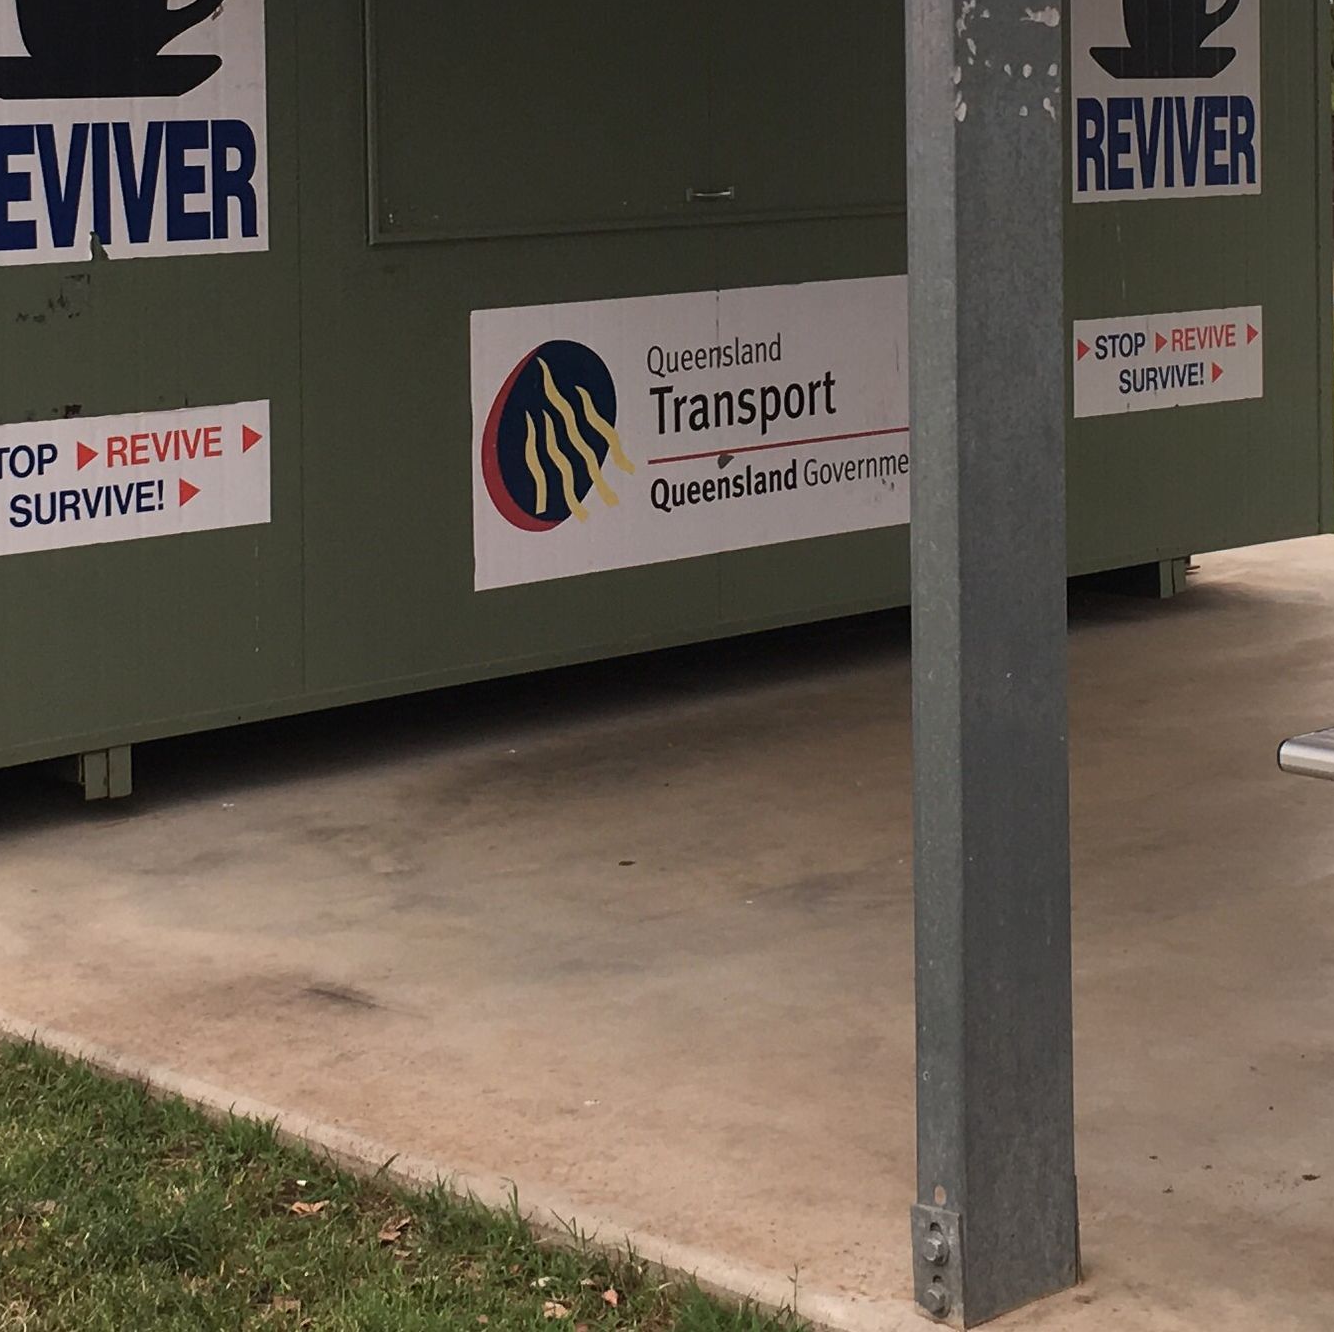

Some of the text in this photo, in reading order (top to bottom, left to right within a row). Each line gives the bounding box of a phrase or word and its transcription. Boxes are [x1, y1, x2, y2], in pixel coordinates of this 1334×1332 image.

[1077, 95, 1256, 191] REVIVER
[647, 332, 782, 378] Queensland
[1095, 324, 1236, 360] STOP REVIVE
[1119, 362, 1204, 394] SURVIVE!
[650, 371, 836, 436] Transport
[107, 426, 222, 468] REVIVE
[9, 480, 164, 528] SURVIVE!
[650, 453, 909, 513] Queensland Governme
